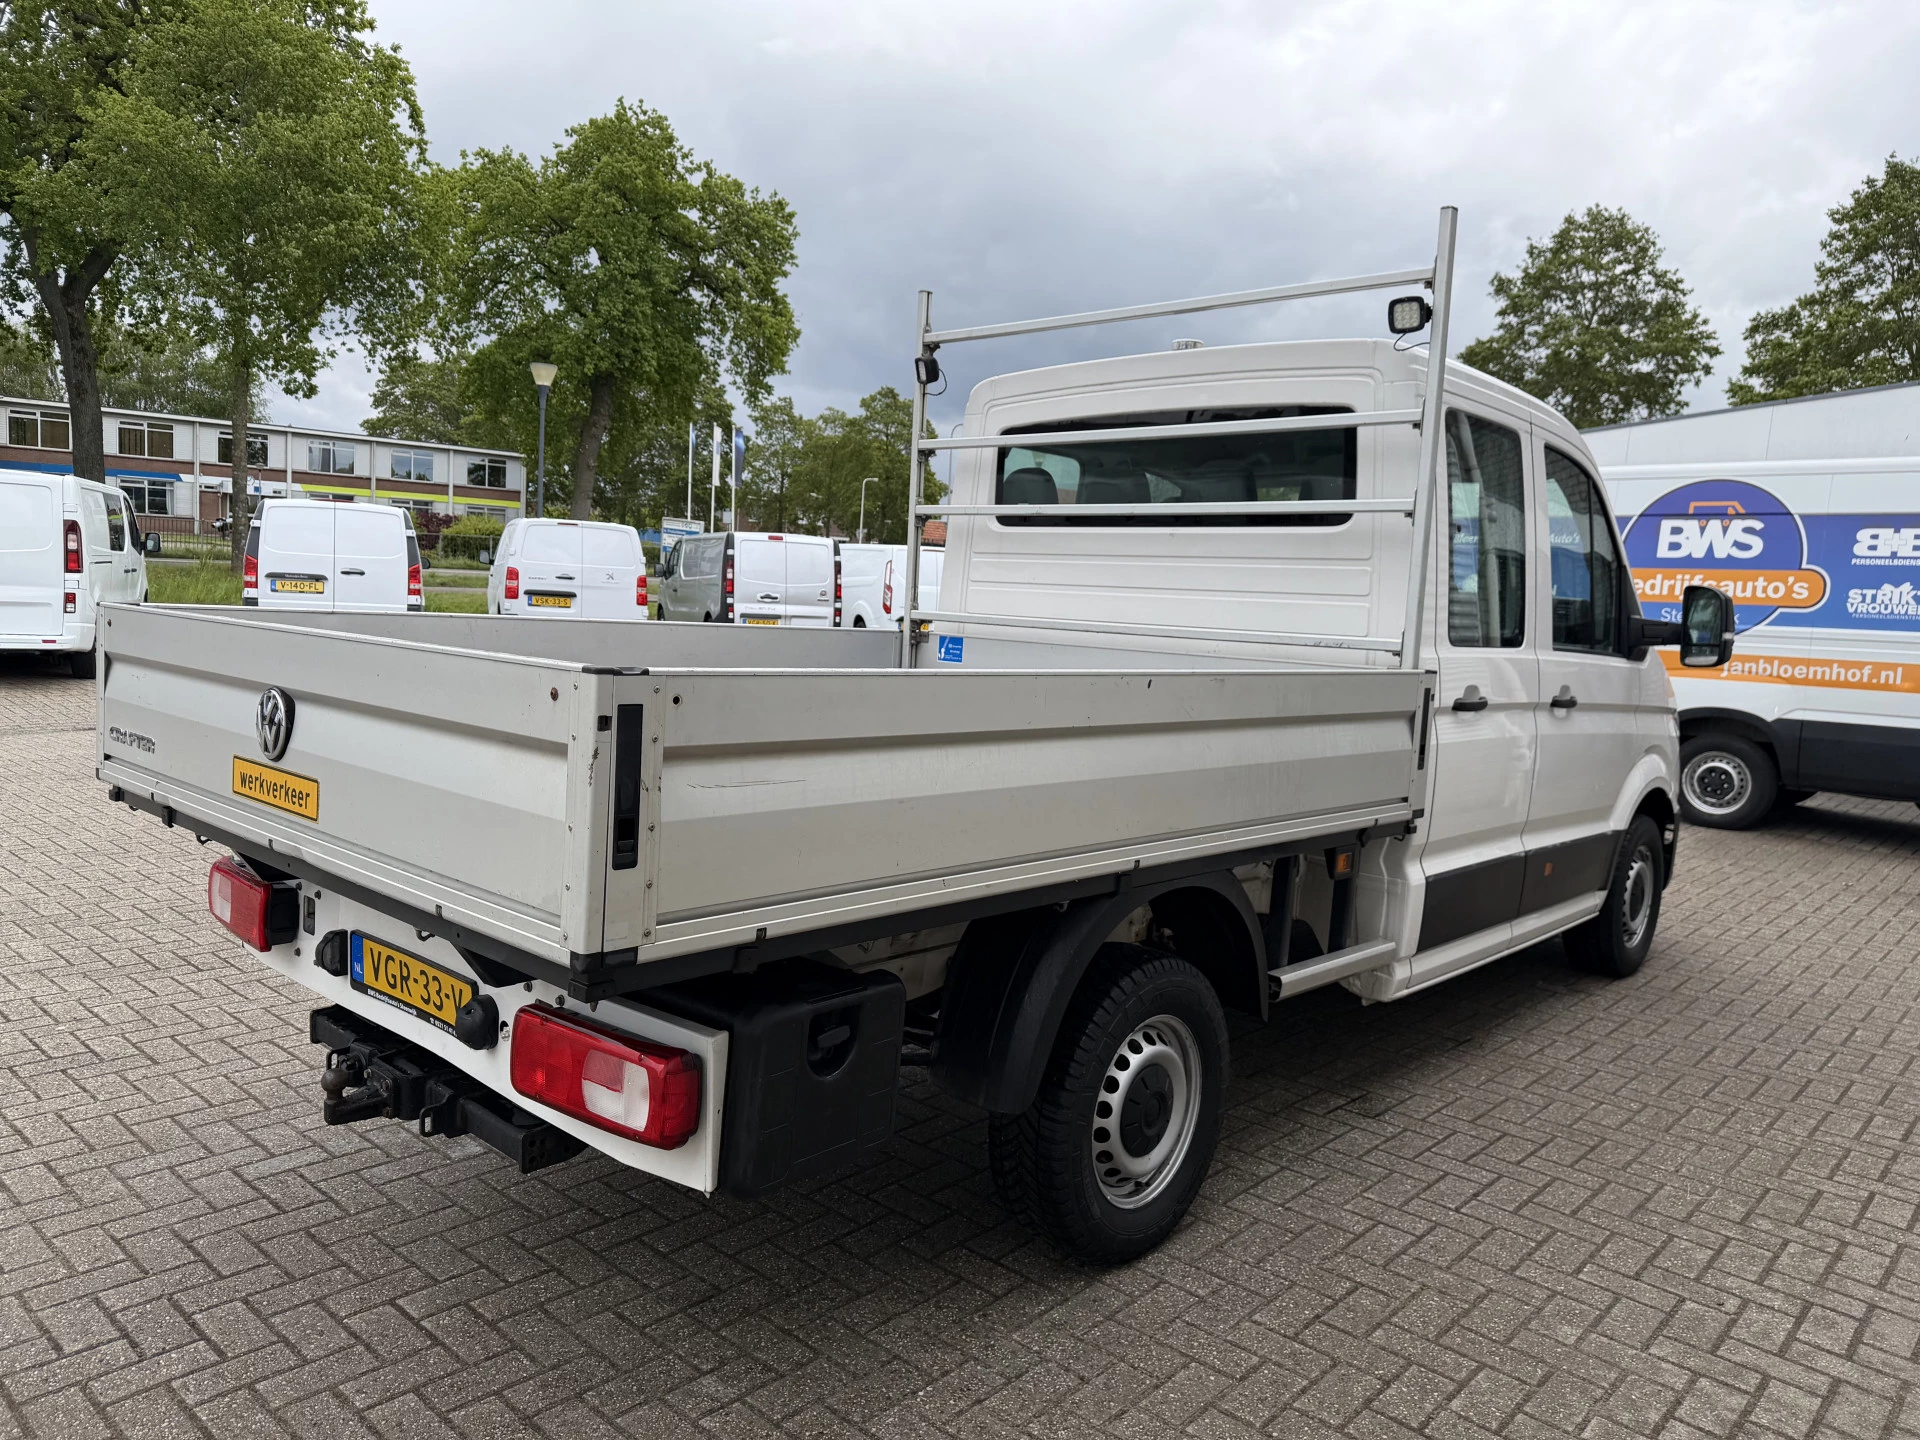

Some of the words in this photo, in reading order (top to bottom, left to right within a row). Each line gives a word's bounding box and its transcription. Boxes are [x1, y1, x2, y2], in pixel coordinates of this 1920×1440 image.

[1656, 519, 1764, 559] BWS
[280, 581, 320, 591] V-140-FL
[1632, 573, 1809, 600] edrijfauto's
[1847, 583, 1920, 605] STRIK
[535, 597, 568, 606] VSK-33-S
[109, 726, 156, 755] CRAFTER
[239, 769, 311, 810] werkverkeer
[354, 961, 363, 974] NL
[369, 947, 463, 1012] VGR-33-V
